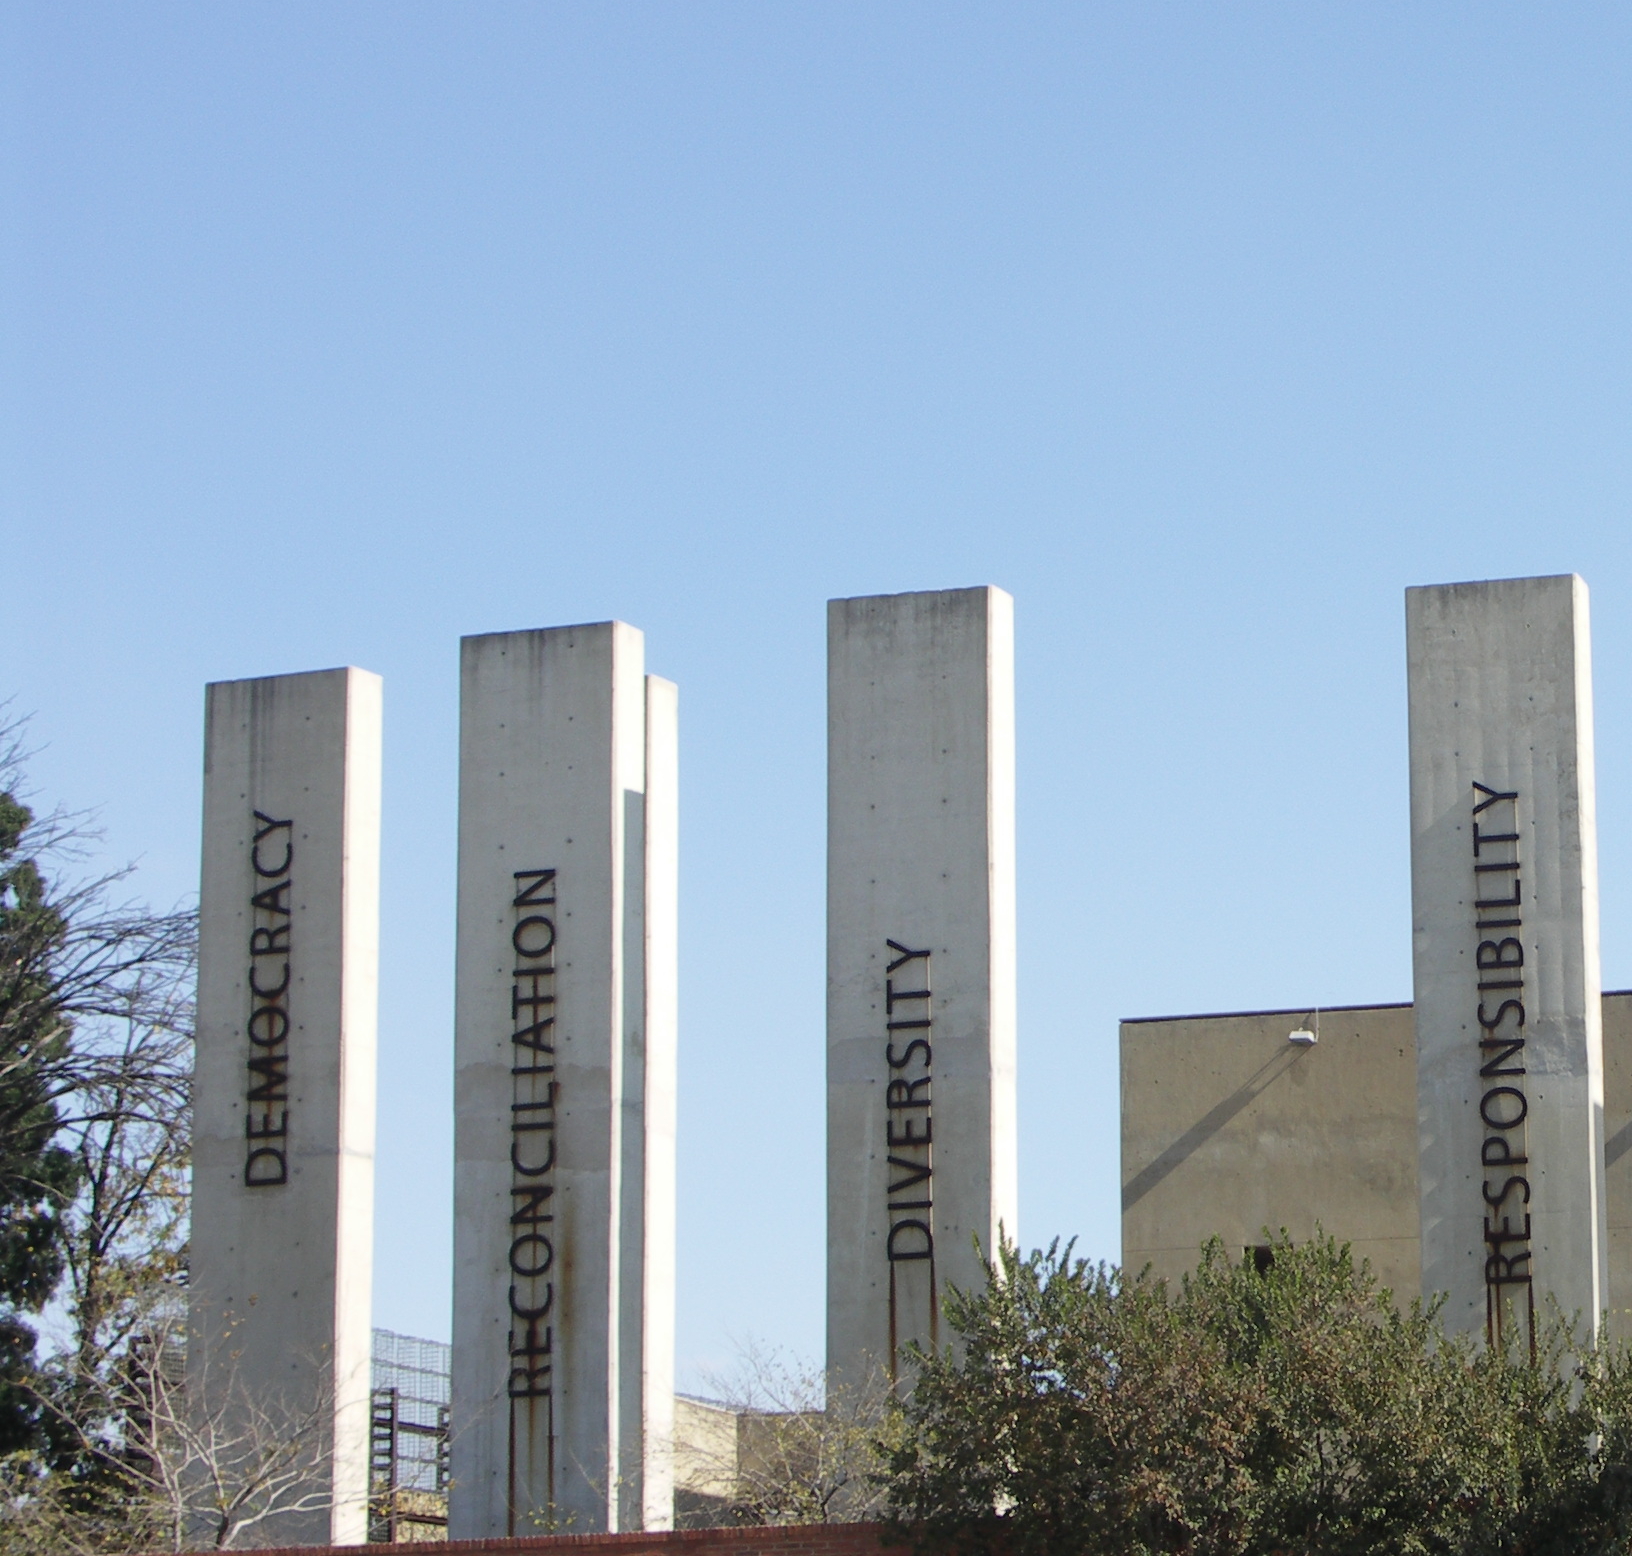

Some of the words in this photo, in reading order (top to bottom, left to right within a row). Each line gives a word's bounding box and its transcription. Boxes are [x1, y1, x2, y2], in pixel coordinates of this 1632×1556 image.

[244, 810, 294, 1189] DEMOCRACY
[507, 868, 557, 1400] RECONCILIATION
[886, 938, 934, 1262] DIVERSITY
[1472, 780, 1534, 1285] RESPONSIBILITY
